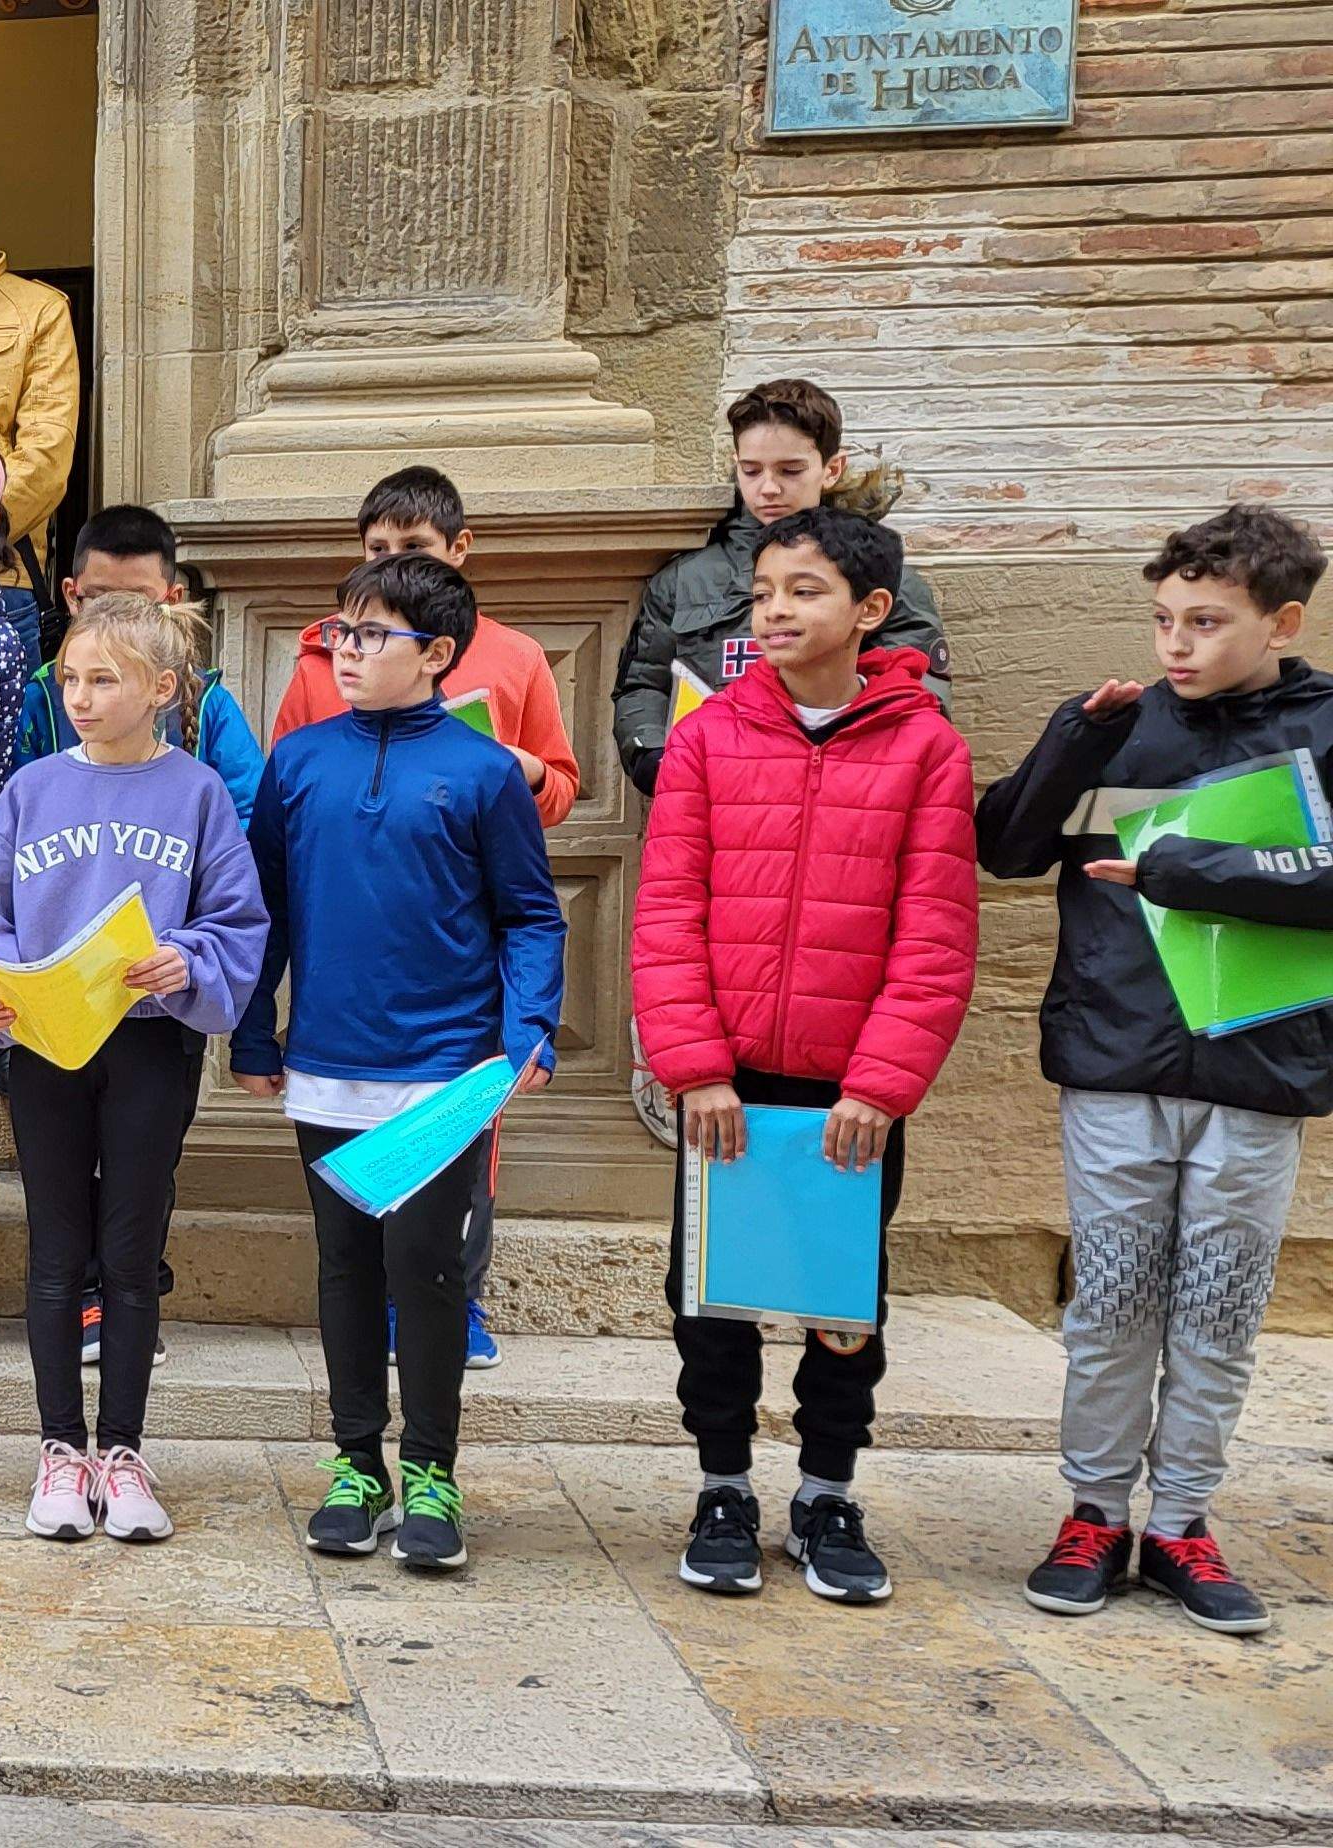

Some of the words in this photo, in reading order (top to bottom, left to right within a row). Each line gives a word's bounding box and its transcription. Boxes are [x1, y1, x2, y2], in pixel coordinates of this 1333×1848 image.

[785, 24, 1063, 65] AYUNTAMIENTO
[822, 72, 857, 96] DE
[870, 64, 1021, 112] HUESCA
[15, 823, 102, 882] NEW
